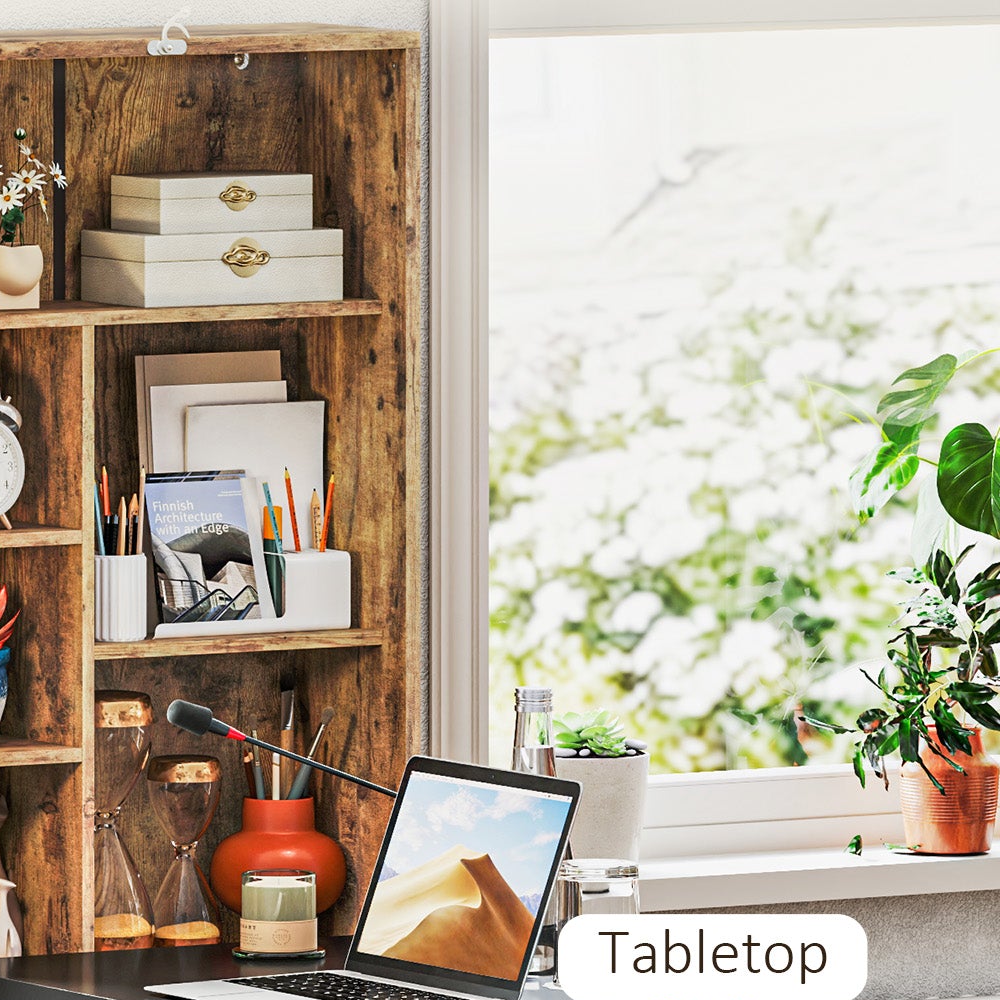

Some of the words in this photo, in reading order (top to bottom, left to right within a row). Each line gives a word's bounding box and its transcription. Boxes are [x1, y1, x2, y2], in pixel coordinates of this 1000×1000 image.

[152, 500, 194, 512] Finnish
[154, 512, 223, 523] Architecture
[156, 524, 180, 535] with
[184, 526, 198, 535] an
[201, 523, 229, 535] Edge
